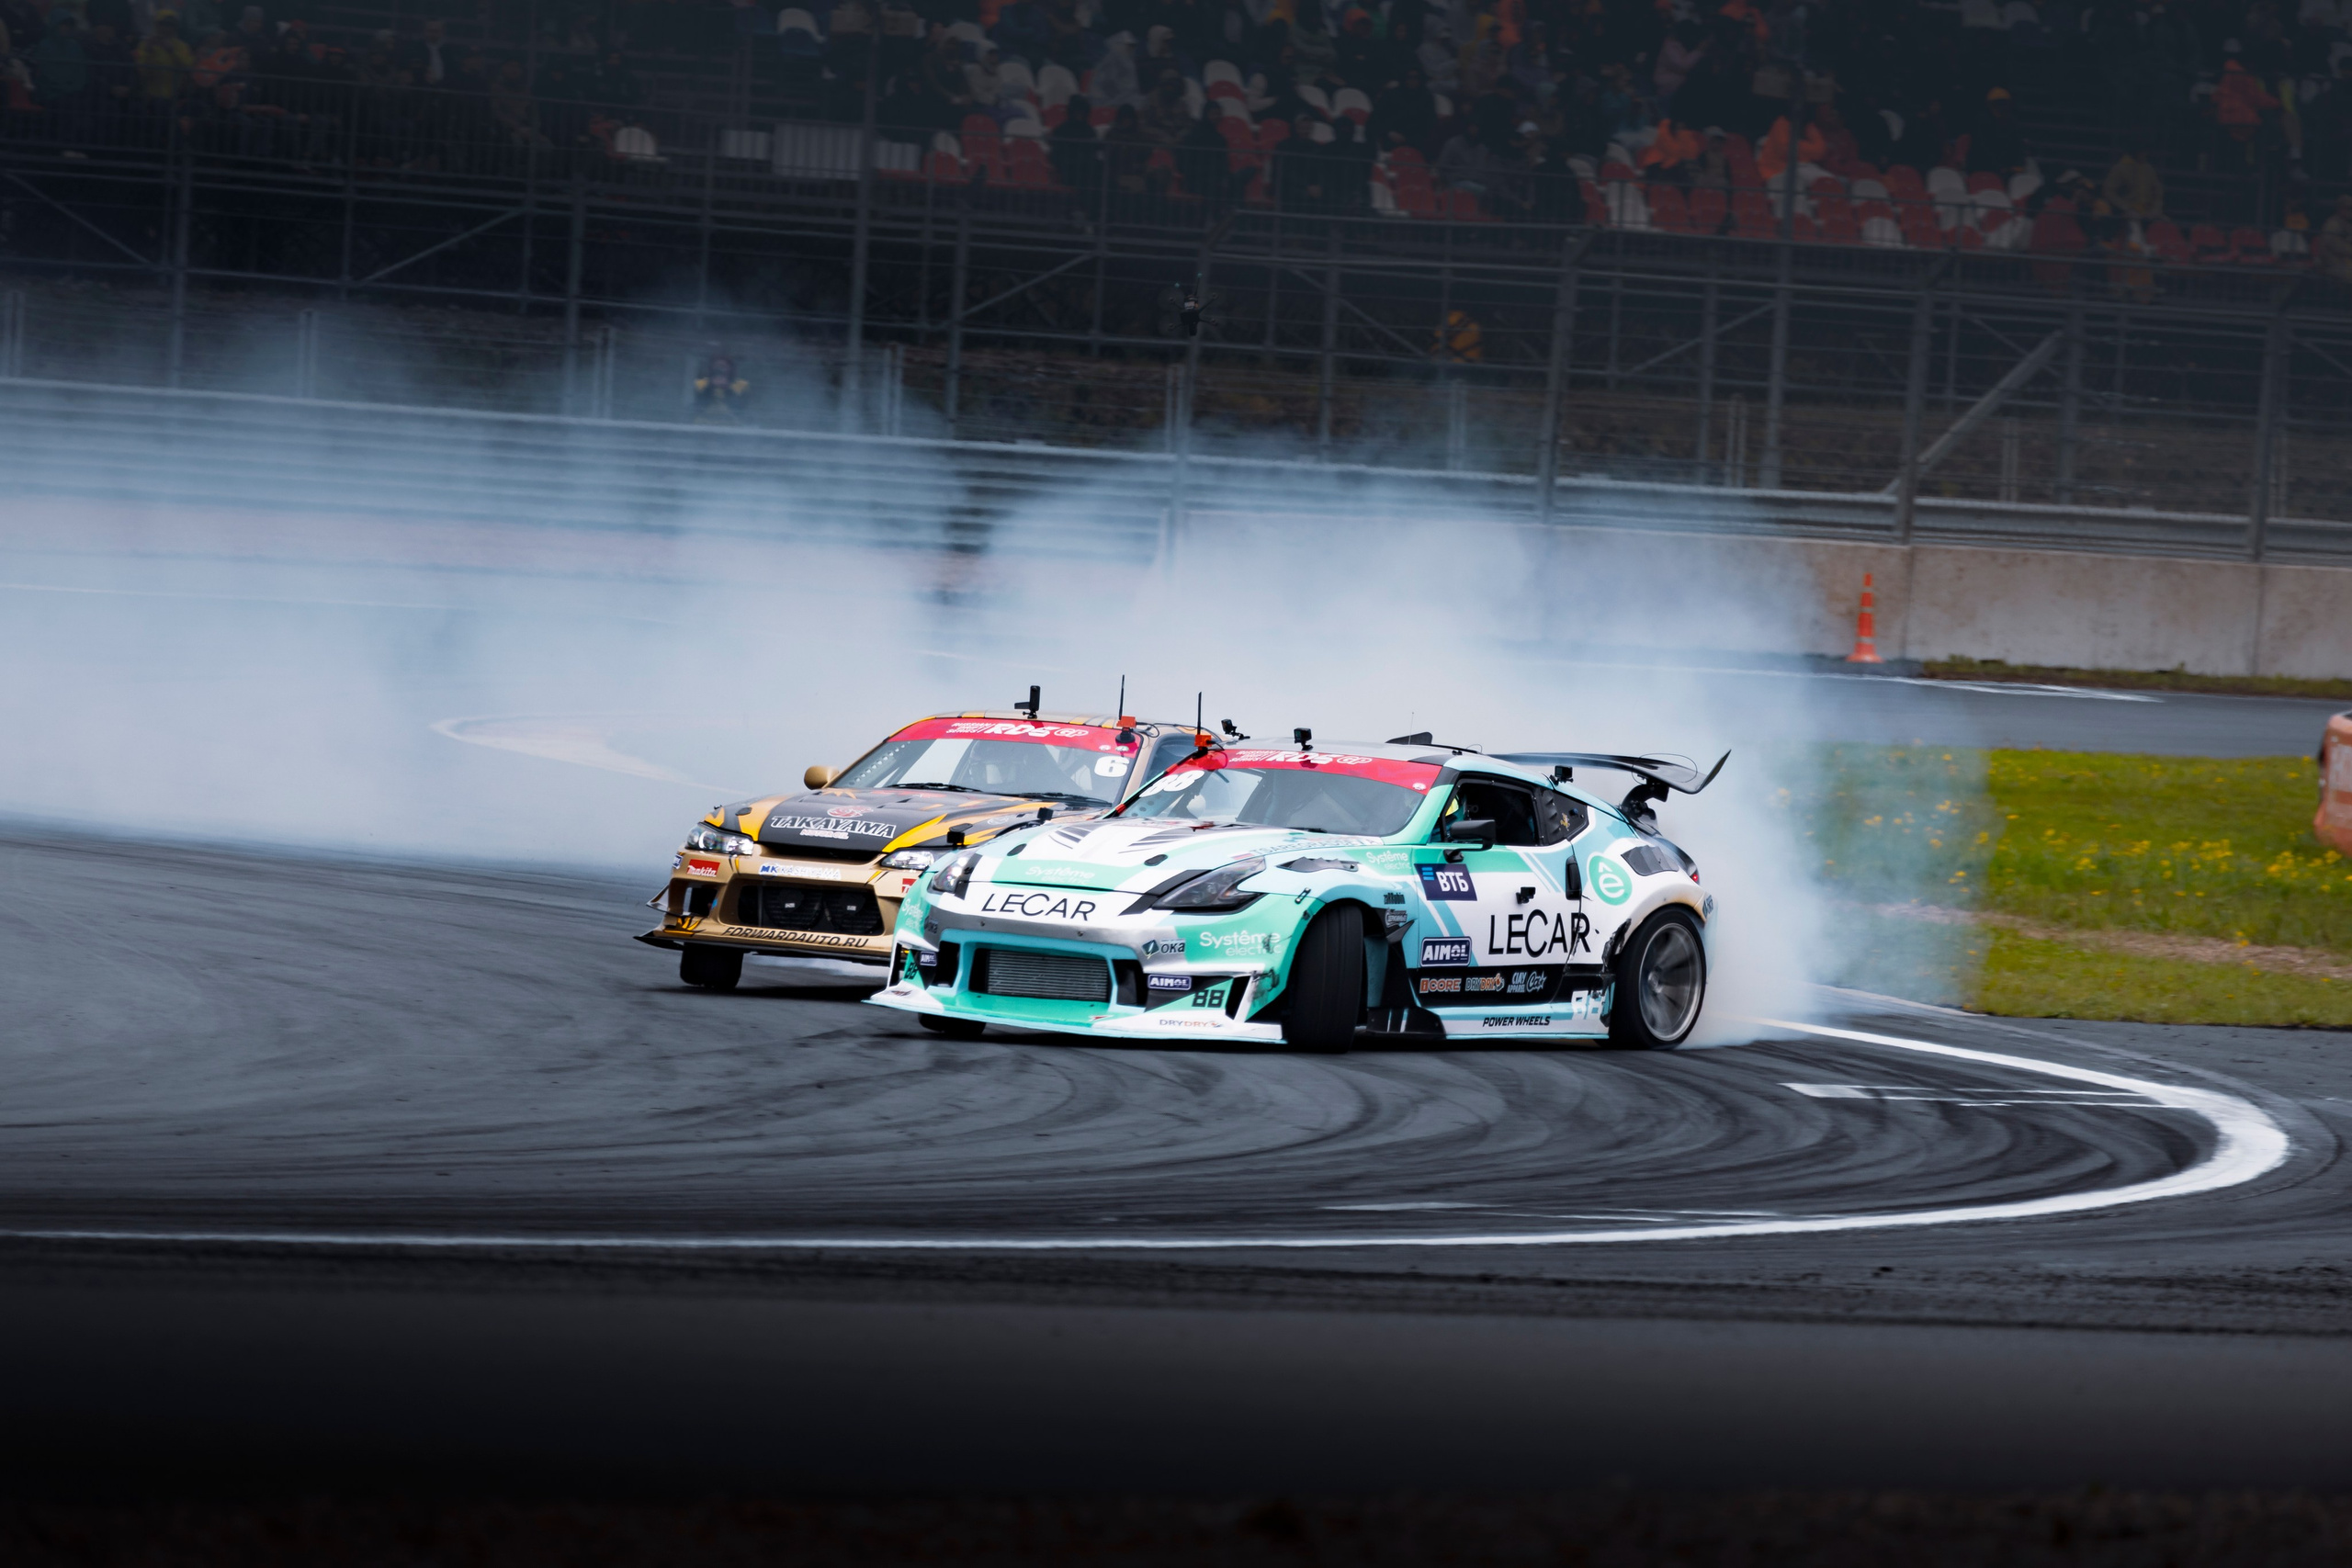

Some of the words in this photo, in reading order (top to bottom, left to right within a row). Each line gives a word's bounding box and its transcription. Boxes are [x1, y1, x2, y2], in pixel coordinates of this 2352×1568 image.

[988, 723, 1060, 737] RDS
[1056, 728, 1087, 738] GP
[1094, 756, 1129, 777] 6
[1266, 751, 1341, 764] RDS
[1338, 756, 1373, 765] GP
[1139, 770, 1205, 797] 88
[771, 816, 897, 839] TAKAYAMA
[687, 865, 718, 877] Makita
[760, 864, 778, 874] MK
[779, 864, 841, 880] KASHIYAMA
[1436, 872, 1469, 892] ВТБ
[980, 893, 1096, 921] LECAR
[722, 927, 869, 948] FORWARDAUTO.RU
[1200, 930, 1281, 948] Système
[1488, 909, 1591, 958] LECAR
[1423, 943, 1468, 962] AIMOL
[1150, 976, 1189, 988] AIMOL
[1192, 989, 1226, 1009] 88
[1159, 1019, 1208, 1028] DRYDRY
[1483, 1017, 1514, 1027] POWER
[1515, 1016, 1551, 1027] WHEELS
